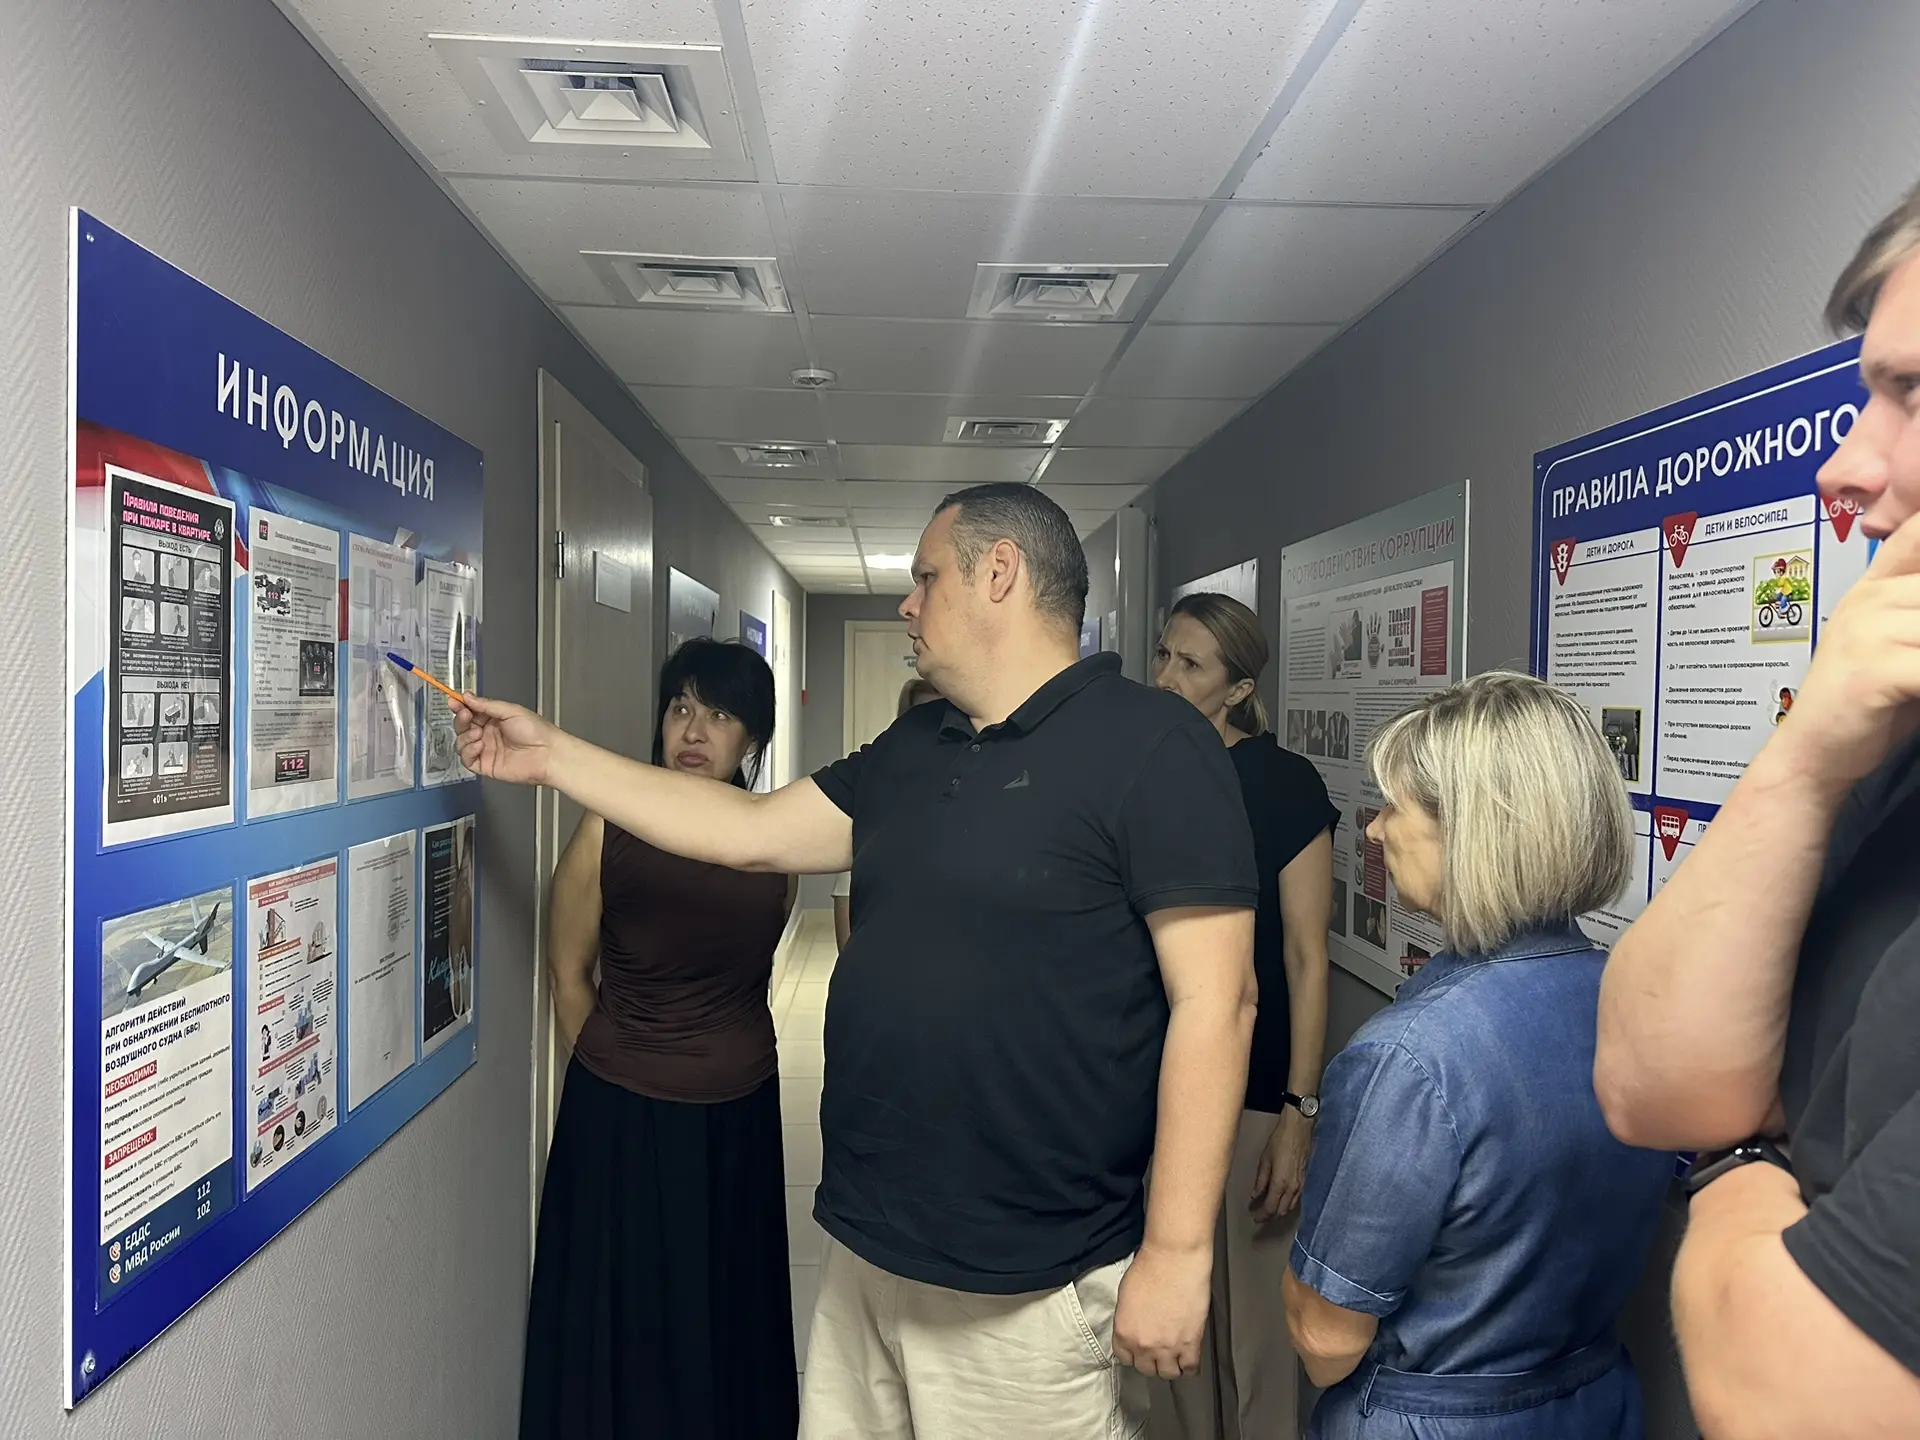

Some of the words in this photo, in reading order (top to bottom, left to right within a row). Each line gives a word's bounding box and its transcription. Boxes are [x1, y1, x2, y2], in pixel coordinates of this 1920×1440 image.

[218, 353, 434, 501] ИНФОРМАЦИЯ
[1553, 465, 1649, 518] ПРАВИЛА
[1656, 403, 1859, 498] ДОРОЖНОГО
[1705, 524, 1724, 536] ДЕТИ
[1727, 522, 1732, 530] И
[1735, 509, 1788, 528] ВЕЛОСИПЕД
[1288, 543, 1376, 588] ПРОТИВОДЕЙСТВИЕ
[1380, 518, 1455, 560] КОРРУПЦИИ
[1586, 547, 1600, 558] ДЕТИ
[1608, 540, 1634, 553] ДОРОГА
[1669, 572, 1694, 580] Велосипед
[1710, 565, 1745, 574] транспортное
[1703, 587, 1744, 596] велосипедистов
[1718, 576, 1744, 585] дорожного
[1389, 607, 1410, 623] ТОЛЬКО
[1389, 622, 1410, 636] ВМЕСТЕ
[157, 681, 178, 689] ВЫХОДА
[282, 759, 304, 770] 112
[105, 1013, 145, 1039] АЛГОРИТМ
[148, 996, 186, 1022] ДЕЙСТВИЙ
[105, 1042, 120, 1056] ПРИ
[123, 1016, 178, 1048] ОБНАРУЖЕНИИ
[181, 994, 230, 1023] БЕСПИЛОТНОГО
[105, 1042, 157, 1073] ВОЗДУШНОГО
[159, 1030, 182, 1047] СУДНА
[184, 1022, 200, 1038] (БВС)
[105, 1063, 157, 1096] НЕОБХОДИМО:
[105, 1098, 127, 1113] Покинуть
[129, 1089, 146, 1101] опасную
[105, 1108, 138, 1130] Предупредить
[143, 1094, 165, 1109] возможной
[166, 1084, 184, 1096] опасности
[105, 1127, 131, 1145] Исключить
[133, 1115, 152, 1129] массовое
[153, 1104, 173, 1118] скопление
[105, 1165, 133, 1185] Находиться
[138, 1152, 152, 1164] прямой
[154, 1140, 174, 1156] видимости
[175, 1133, 183, 1142] БВС
[109, 1132, 154, 1165] ЗАПРЕЩЕНО:
[105, 1177, 138, 1201] Пользоваться
[140, 1168, 153, 1179] вблизи
[154, 1160, 162, 1169] БВС
[164, 1145, 189, 1165] устройствами
[190, 1138, 198, 1148] GPS
[105, 1184, 151, 1216] Взаимодействовать
[174, 1163, 182, 1172] БВС
[125, 1222, 150, 1250] ЕДДС
[197, 1181, 210, 1200] 112
[125, 1246, 148, 1273] МВД
[150, 1226, 180, 1255] России
[197, 1200, 210, 1220] 102
